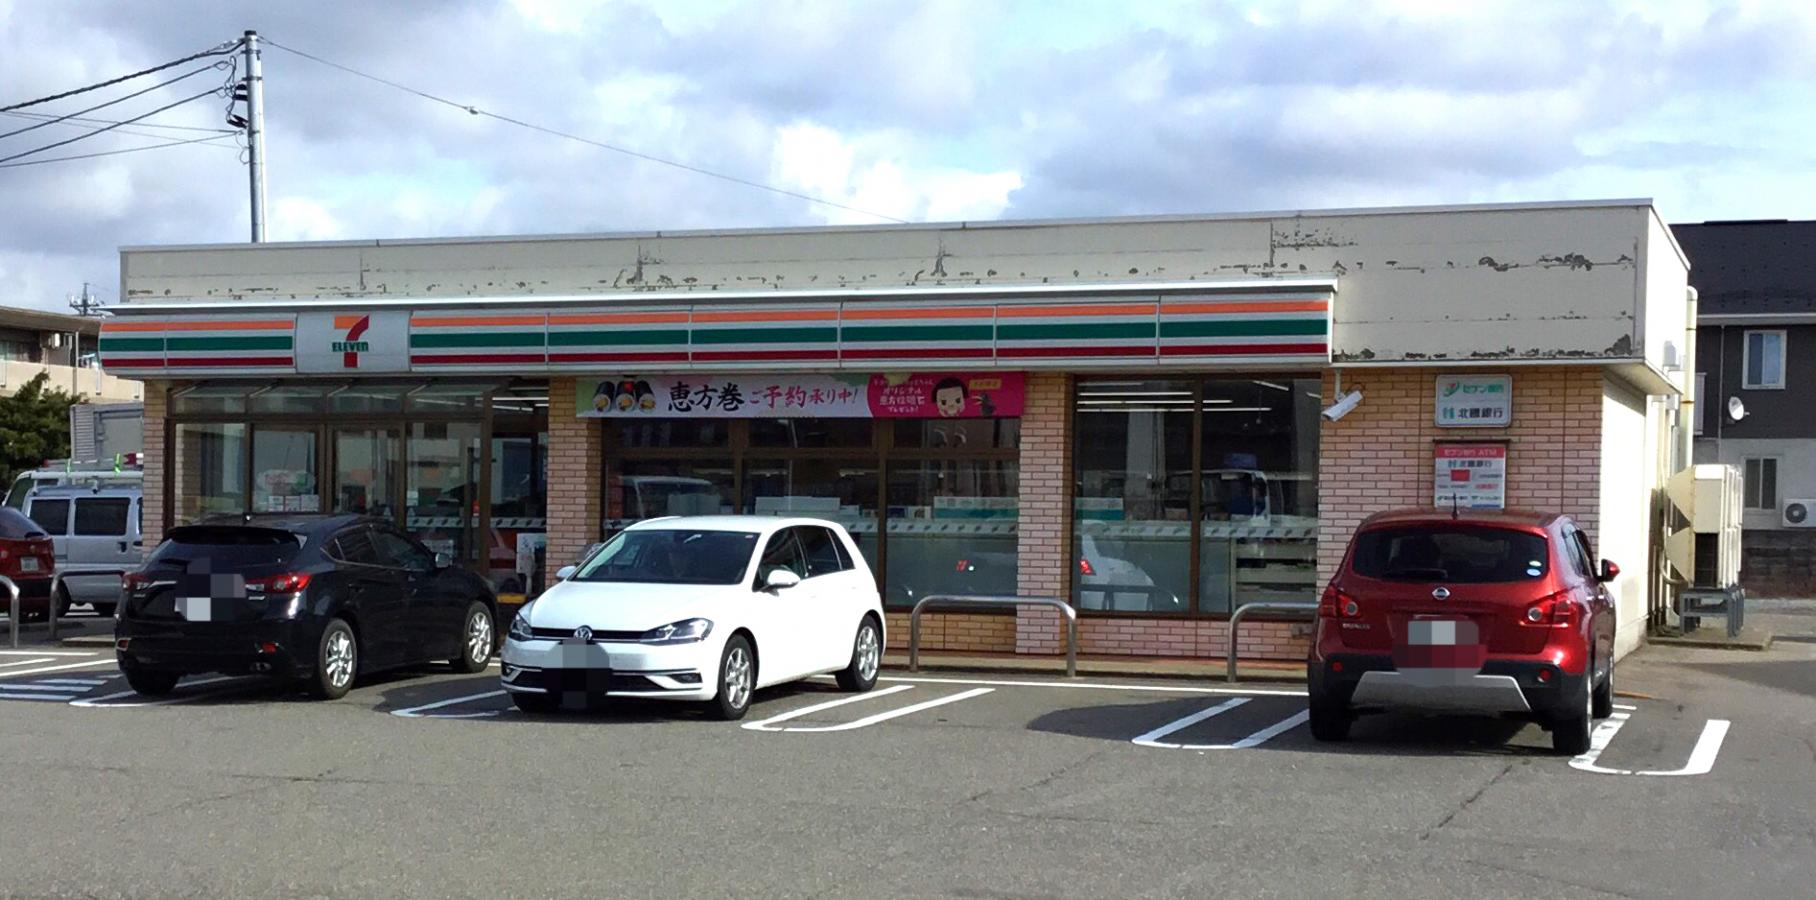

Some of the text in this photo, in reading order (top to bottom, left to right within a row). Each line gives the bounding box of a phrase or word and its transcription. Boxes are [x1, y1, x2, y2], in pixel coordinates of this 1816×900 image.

[334, 314, 370, 368] 7
[668, 381, 745, 412] 恵方巻
[1478, 448, 1497, 457] ATM
